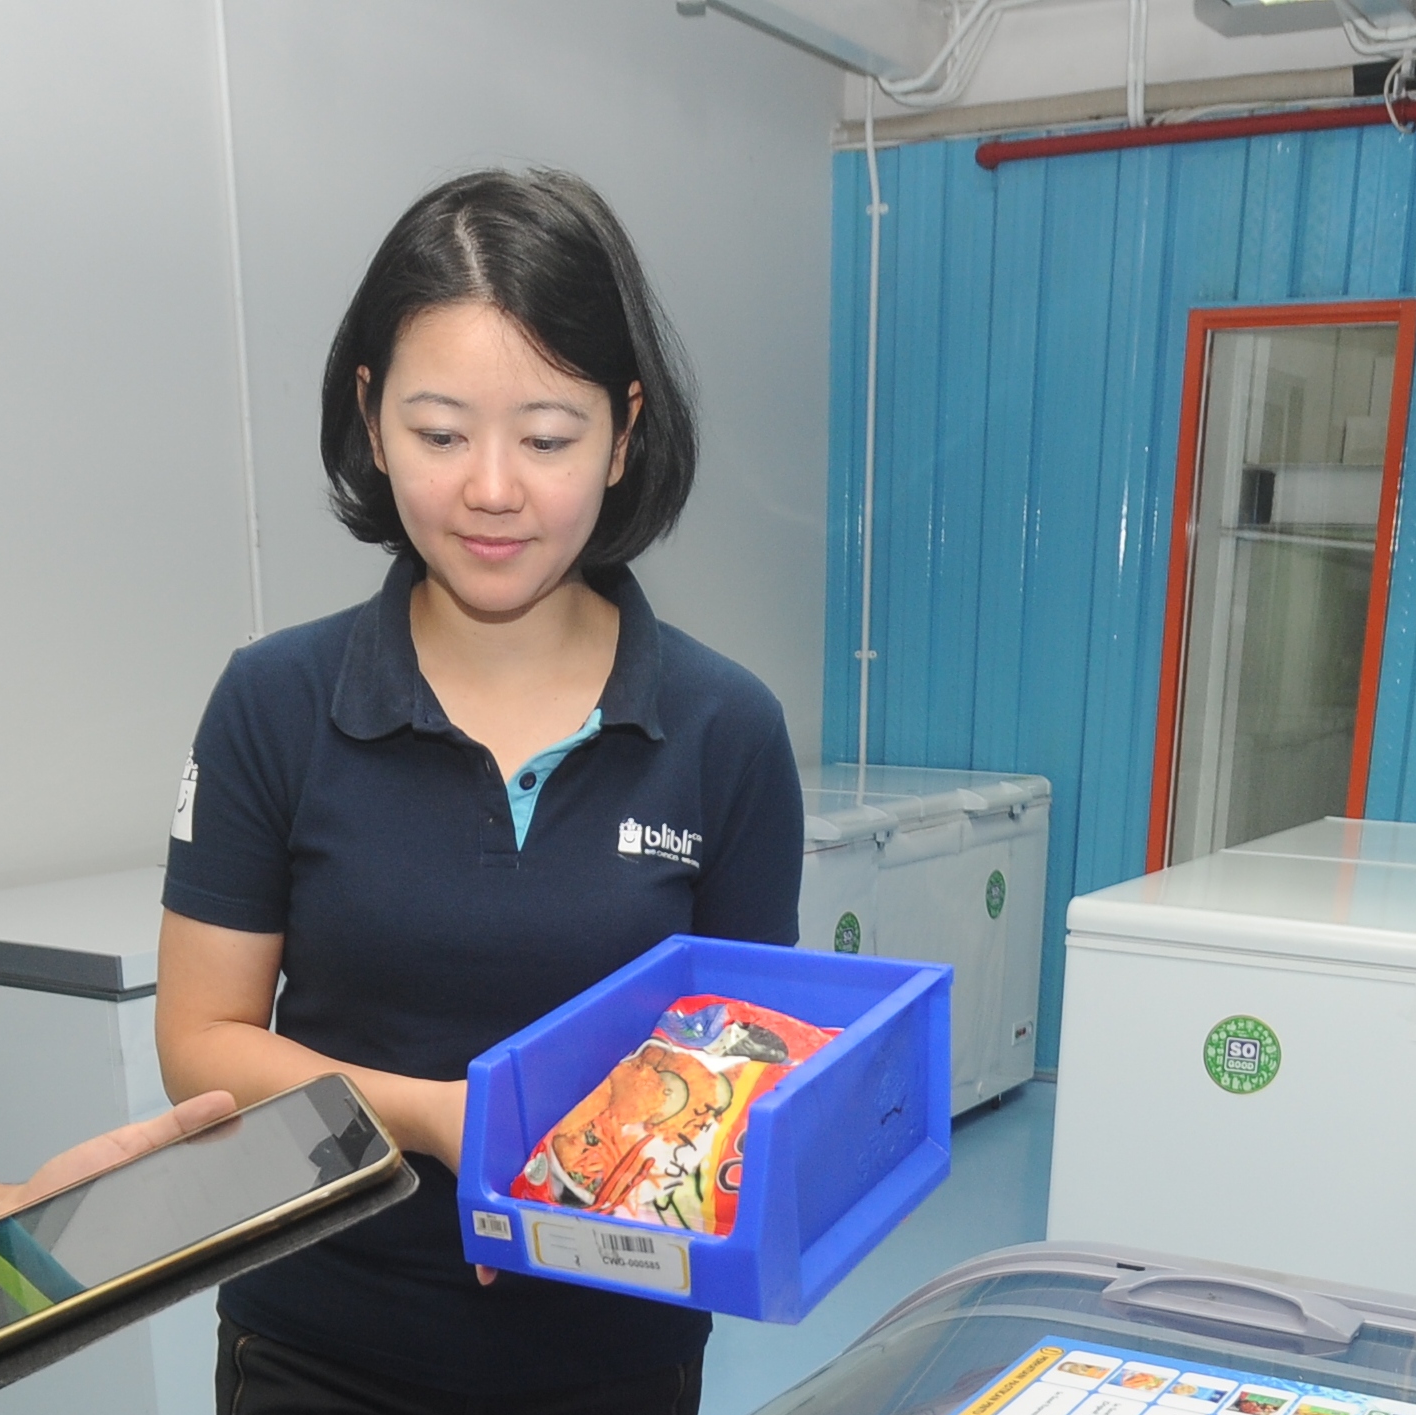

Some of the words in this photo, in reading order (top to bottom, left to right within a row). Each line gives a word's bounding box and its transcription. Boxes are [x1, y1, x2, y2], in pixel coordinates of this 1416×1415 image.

[645, 823, 692, 855] blibli
[1230, 1042, 1255, 1057] SO
[1228, 1060, 1254, 1069] GOOD
